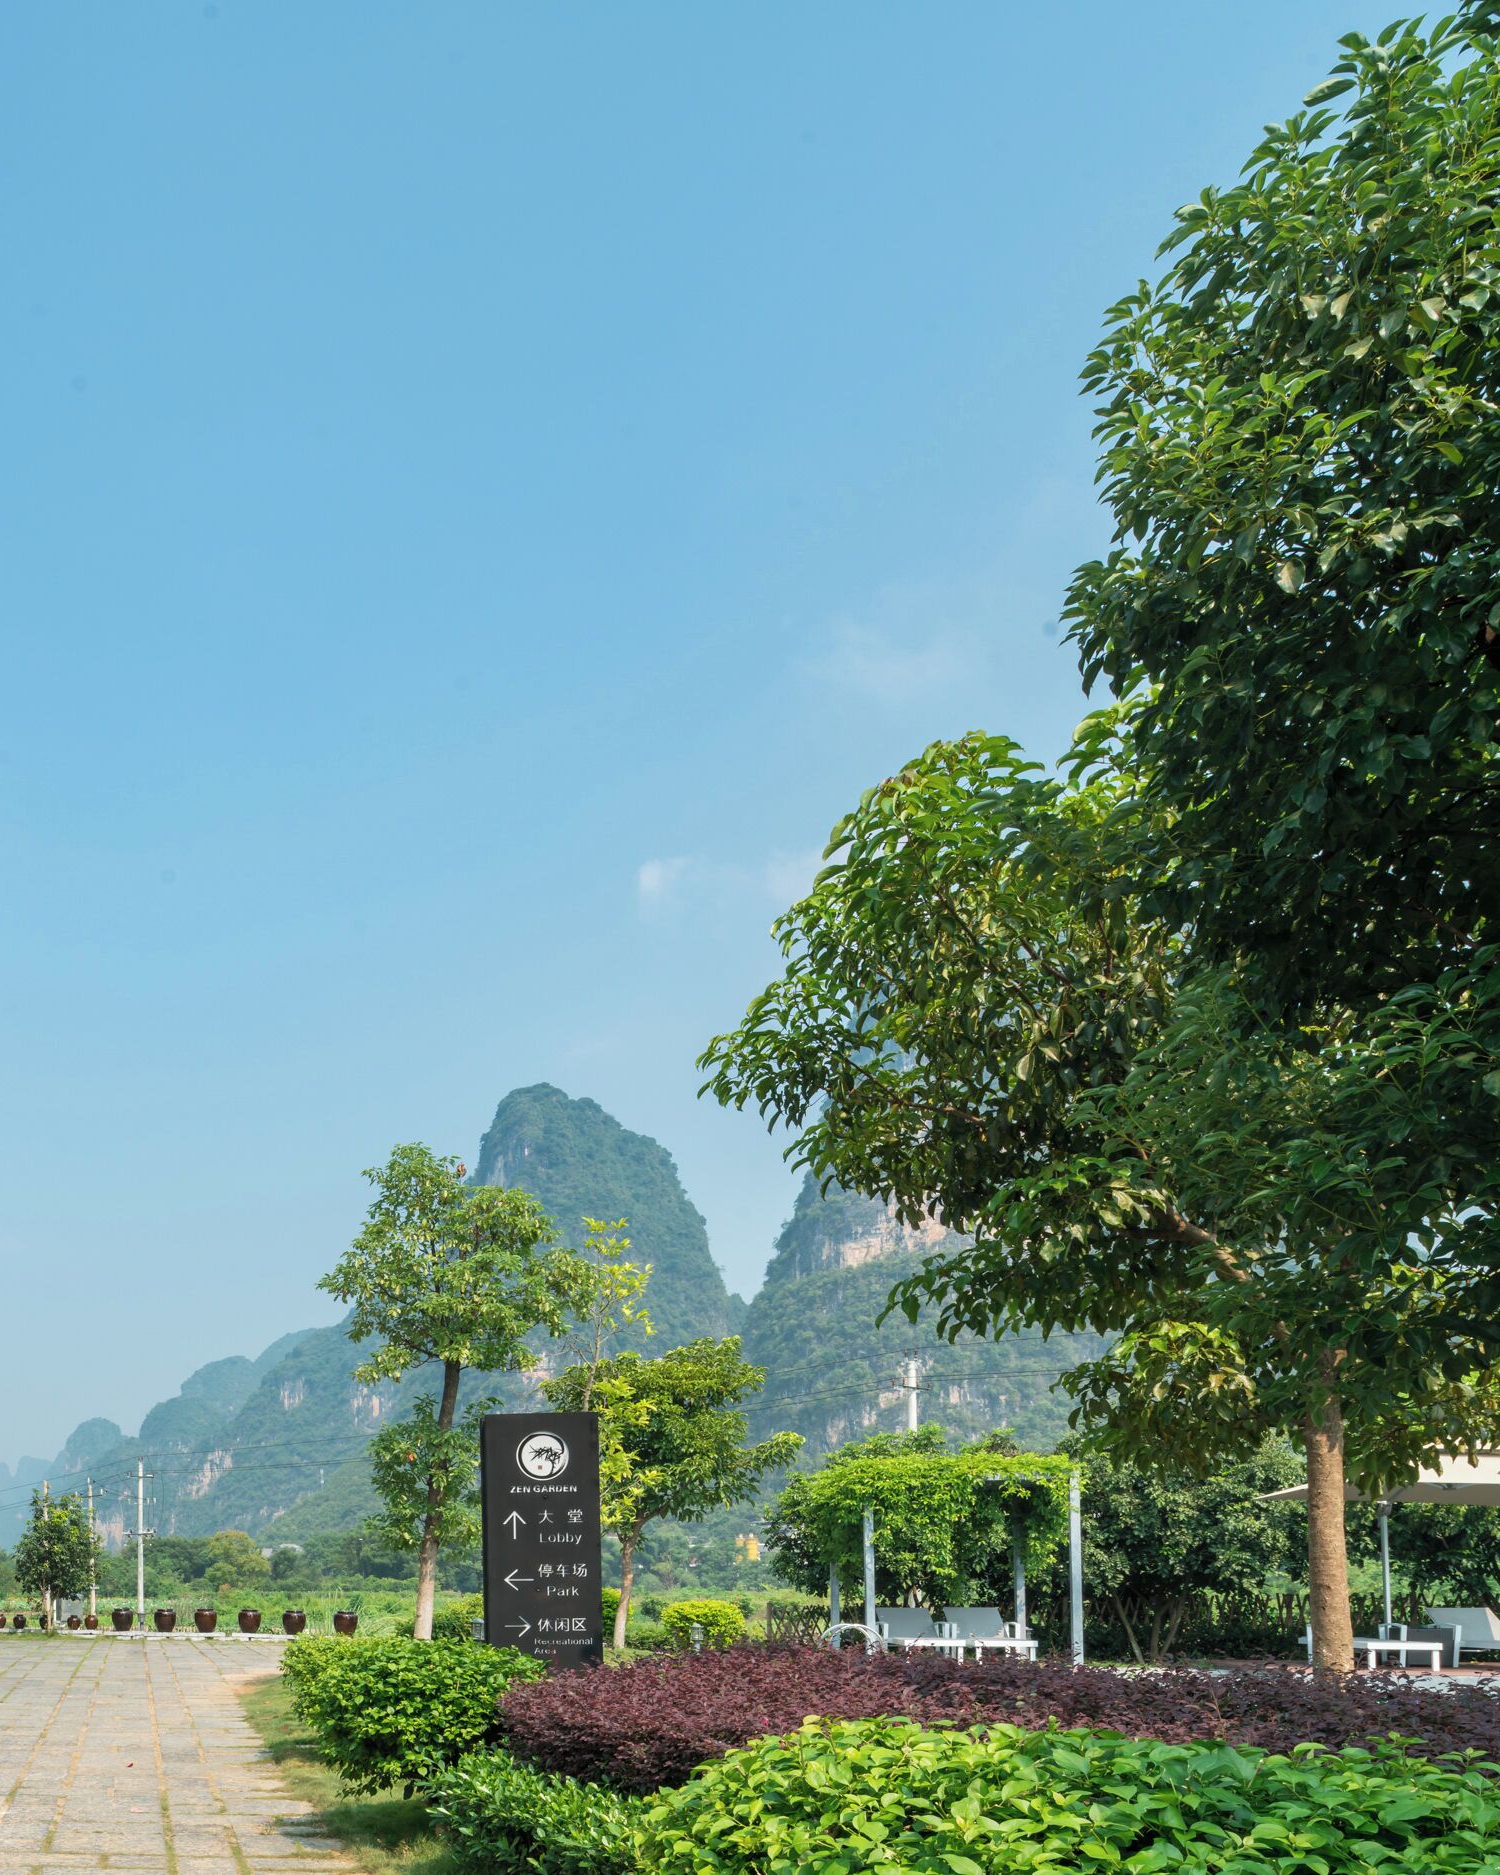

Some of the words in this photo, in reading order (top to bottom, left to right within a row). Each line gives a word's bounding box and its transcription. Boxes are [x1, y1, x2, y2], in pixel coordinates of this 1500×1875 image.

[510, 1485, 531, 1494] ZEN
[533, 1484, 578, 1493] GARDEN
[539, 1532, 582, 1545] Lobby
[538, 1563, 588, 1578] 停车场
[546, 1585, 580, 1597] Park
[537, 1617, 588, 1632] 休闲区
[534, 1637, 593, 1646] Recreational
